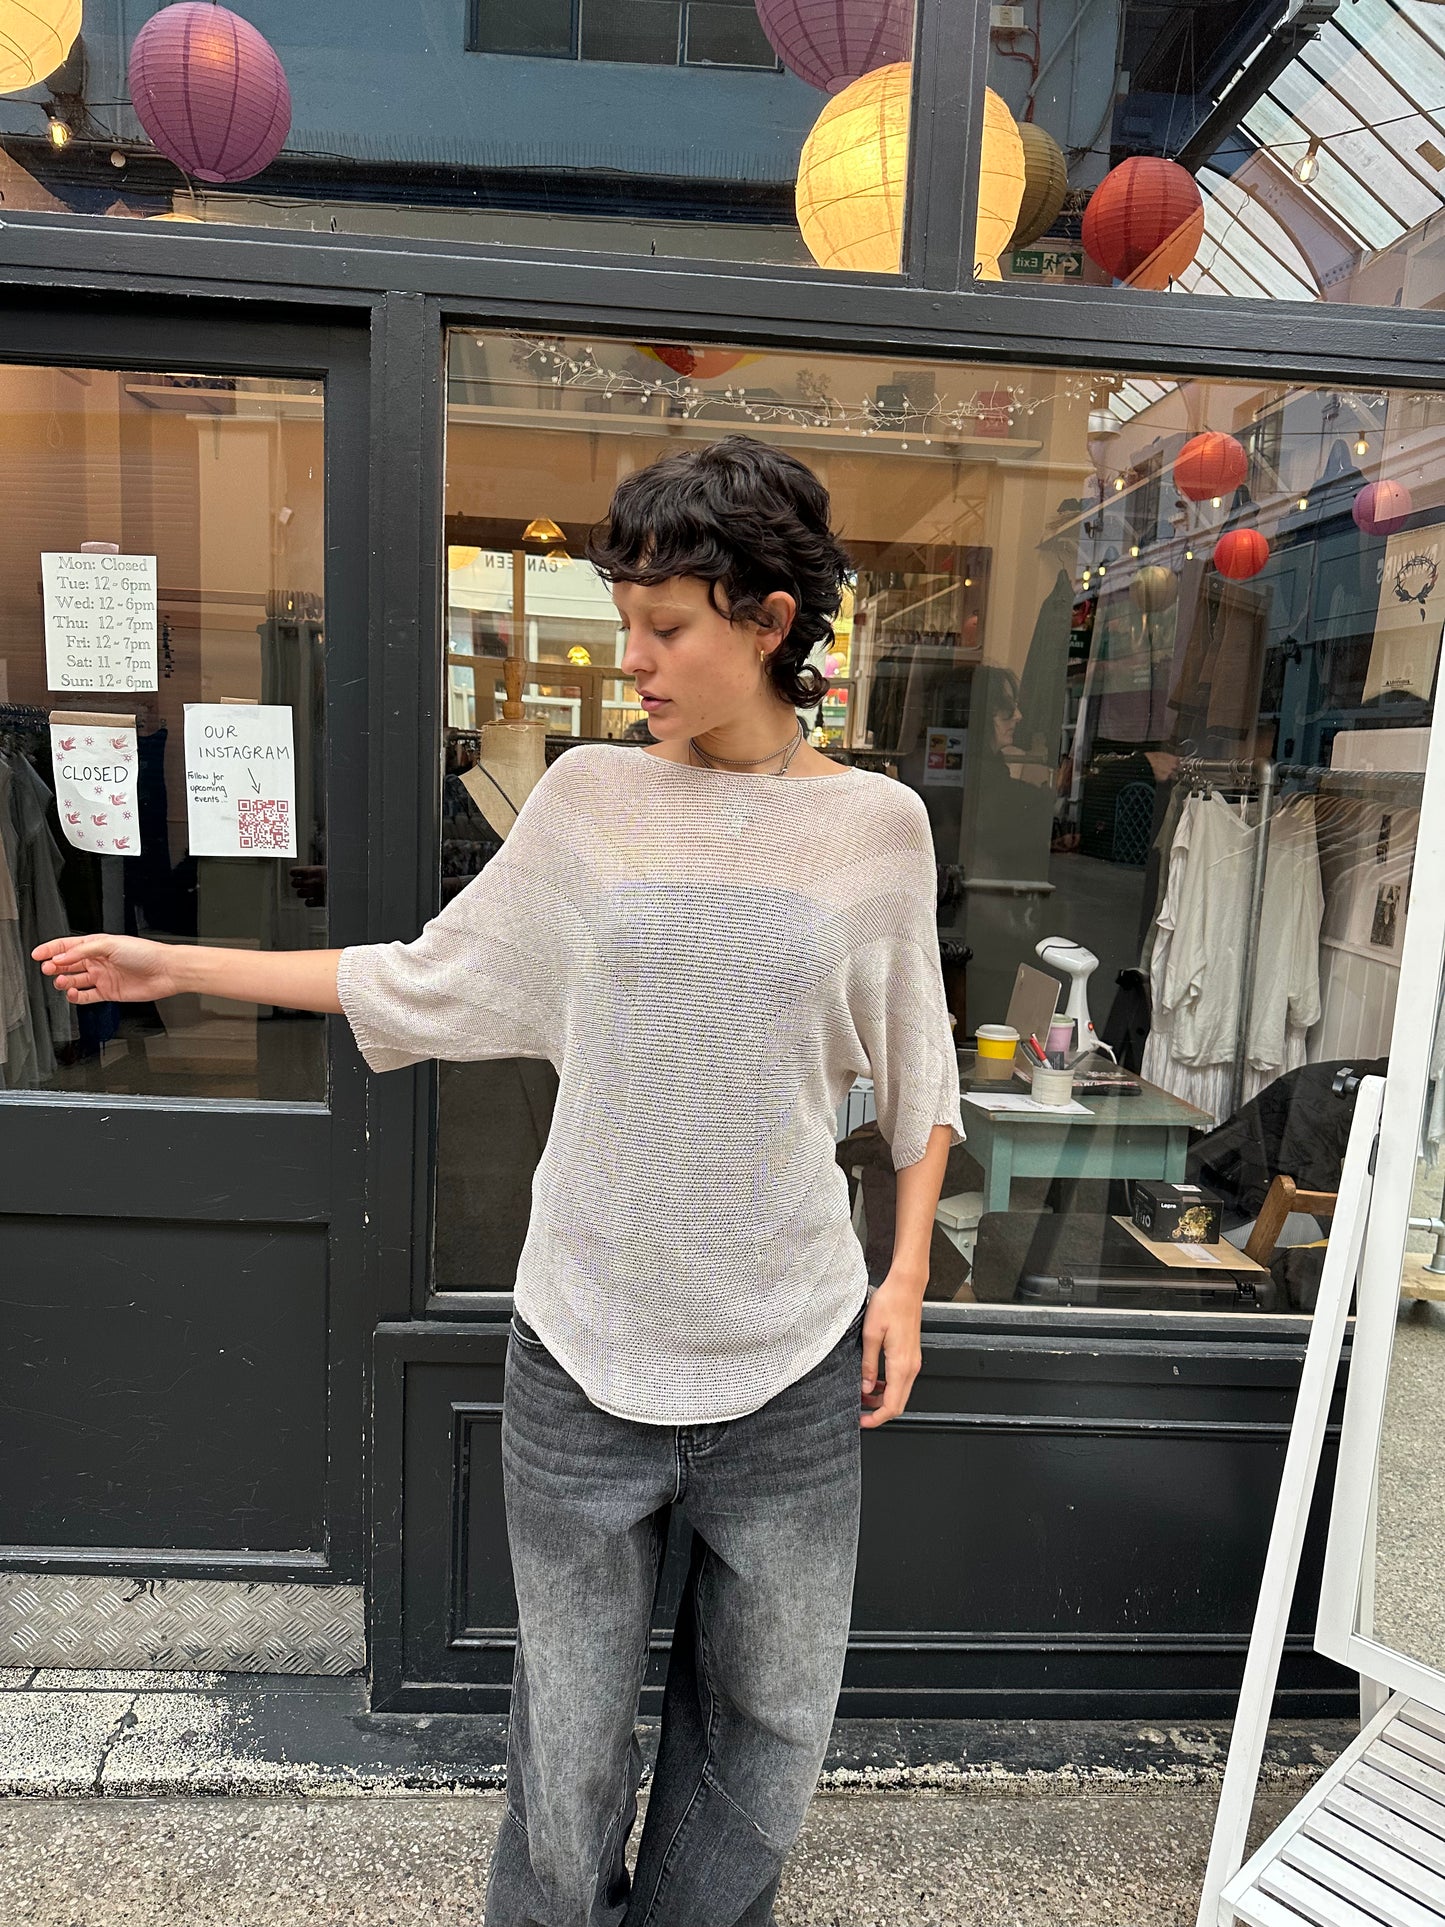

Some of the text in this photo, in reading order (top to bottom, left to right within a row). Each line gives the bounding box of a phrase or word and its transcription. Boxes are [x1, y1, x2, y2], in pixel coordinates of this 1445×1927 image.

[58, 556, 148, 571] Mon: Closed
[56, 576, 89, 590] Tue:
[55, 596, 94, 610] Wed:
[52, 615, 88, 629] Thu:
[65, 635, 91, 648] Fri:
[66, 654, 92, 668] Sat:
[61, 673, 93, 687] Sun:
[204, 725, 238, 739] OUR
[199, 745, 290, 760] INSTAGRAM
[62, 764, 129, 784] CLOSED
[187, 771, 224, 786] Follow for
[190, 784, 228, 798] upcoming
